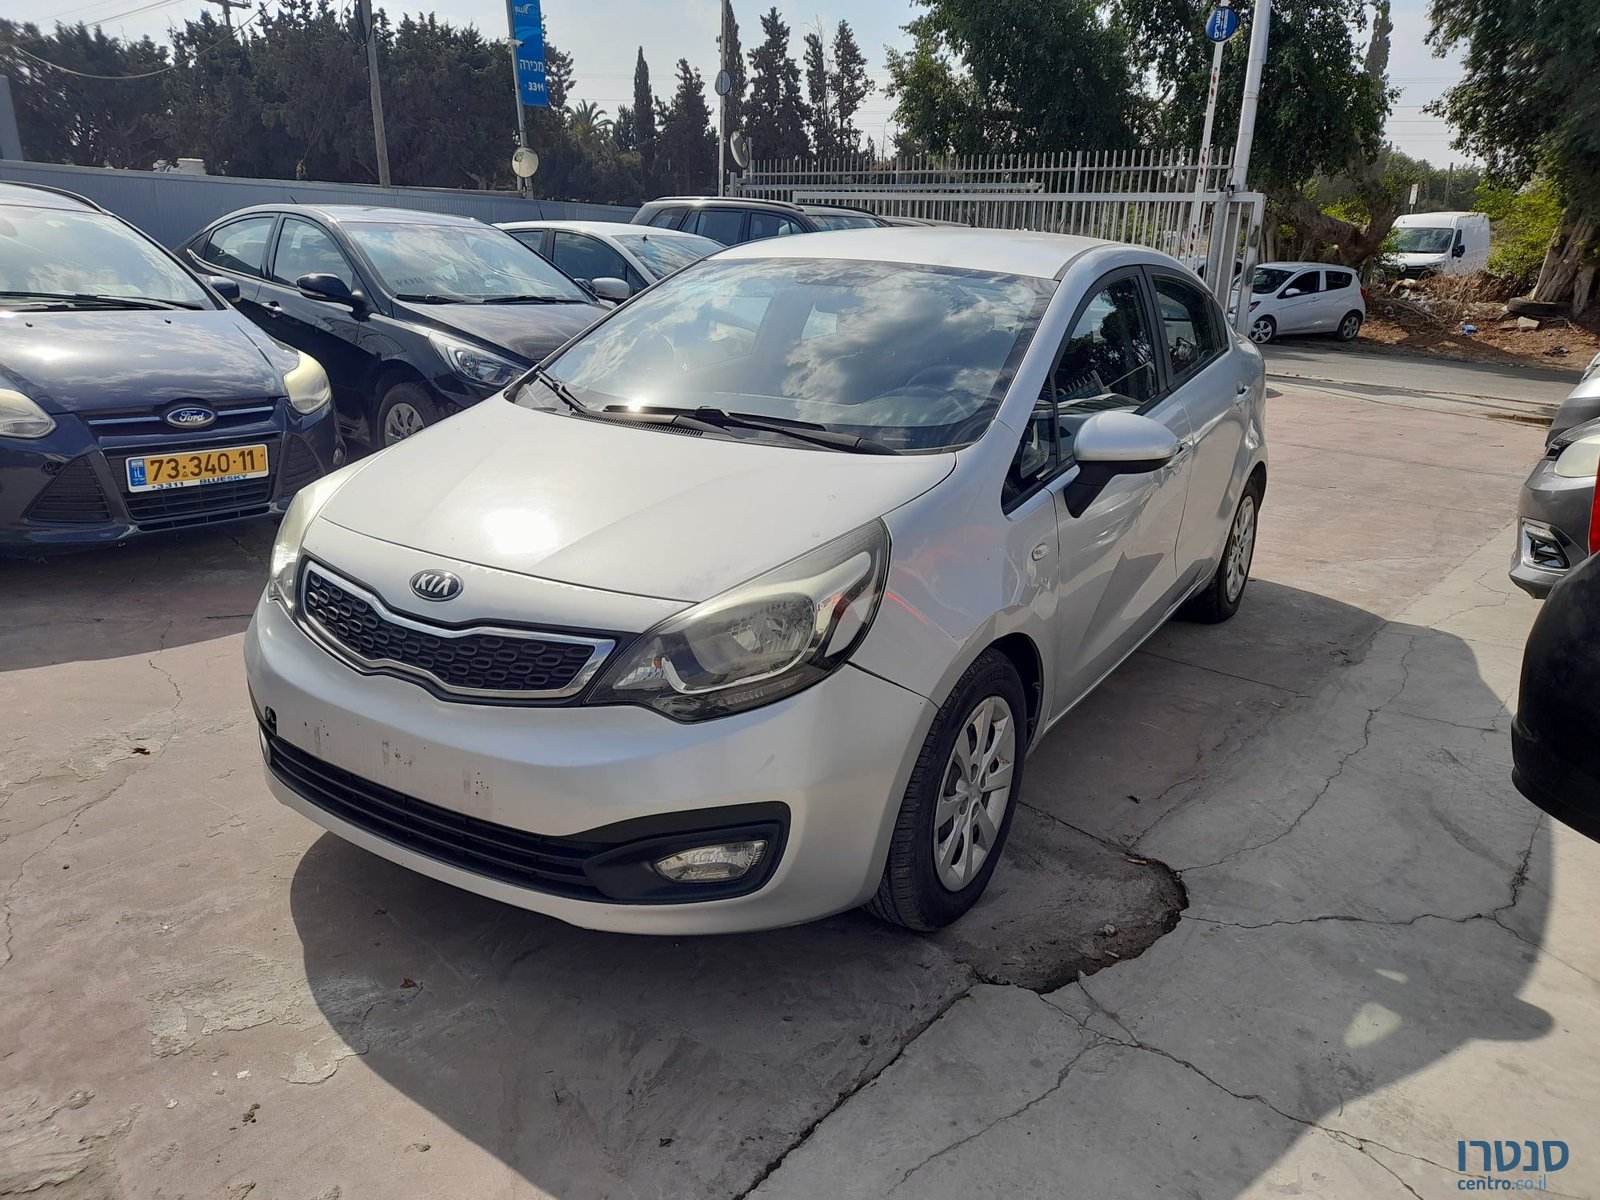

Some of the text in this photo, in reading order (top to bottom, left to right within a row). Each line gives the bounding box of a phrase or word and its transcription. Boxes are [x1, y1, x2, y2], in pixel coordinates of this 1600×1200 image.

[519, 59, 545, 72] מכירה
[179, 410, 206, 422] Ford
[199, 473, 248, 485] BLUESKY
[415, 573, 452, 596] KIA
